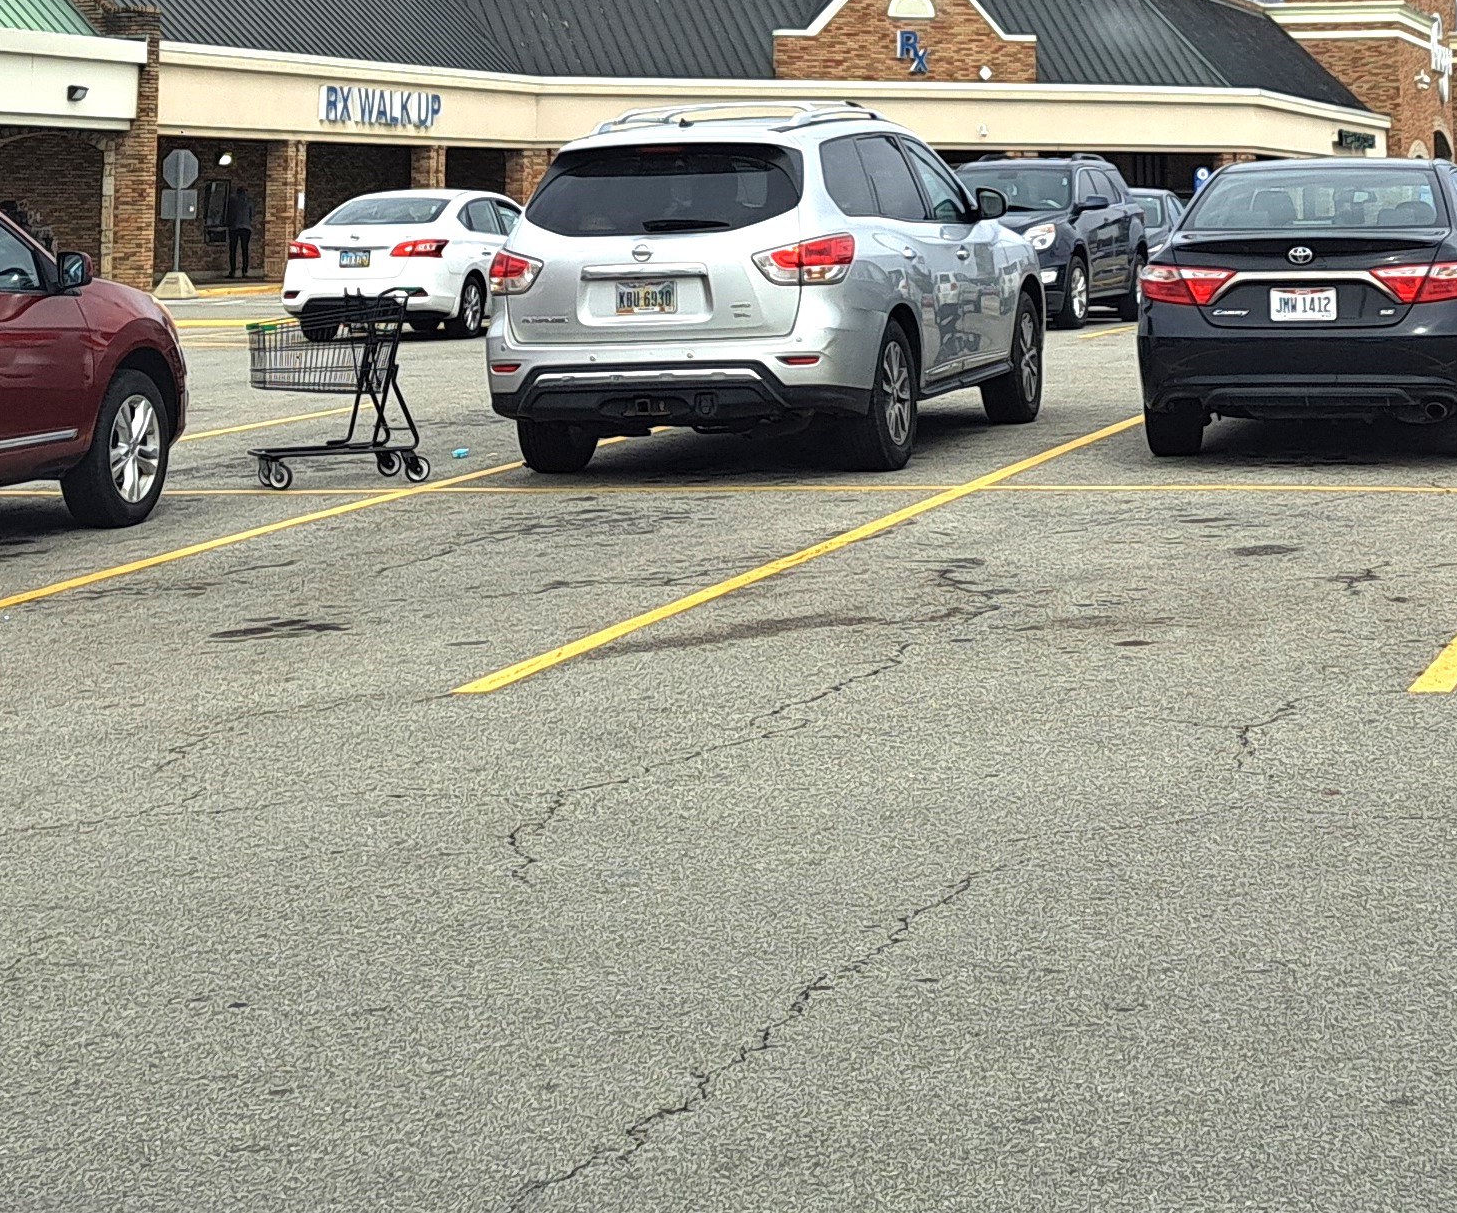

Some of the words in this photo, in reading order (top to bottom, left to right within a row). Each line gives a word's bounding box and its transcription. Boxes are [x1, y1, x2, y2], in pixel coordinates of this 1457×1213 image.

[320, 85, 352, 123] RX
[356, 87, 412, 126] WALK
[415, 91, 442, 127] UP
[643, 289, 672, 308] 6930
[1275, 296, 1298, 314] JMW
[1301, 296, 1332, 314] 1412
